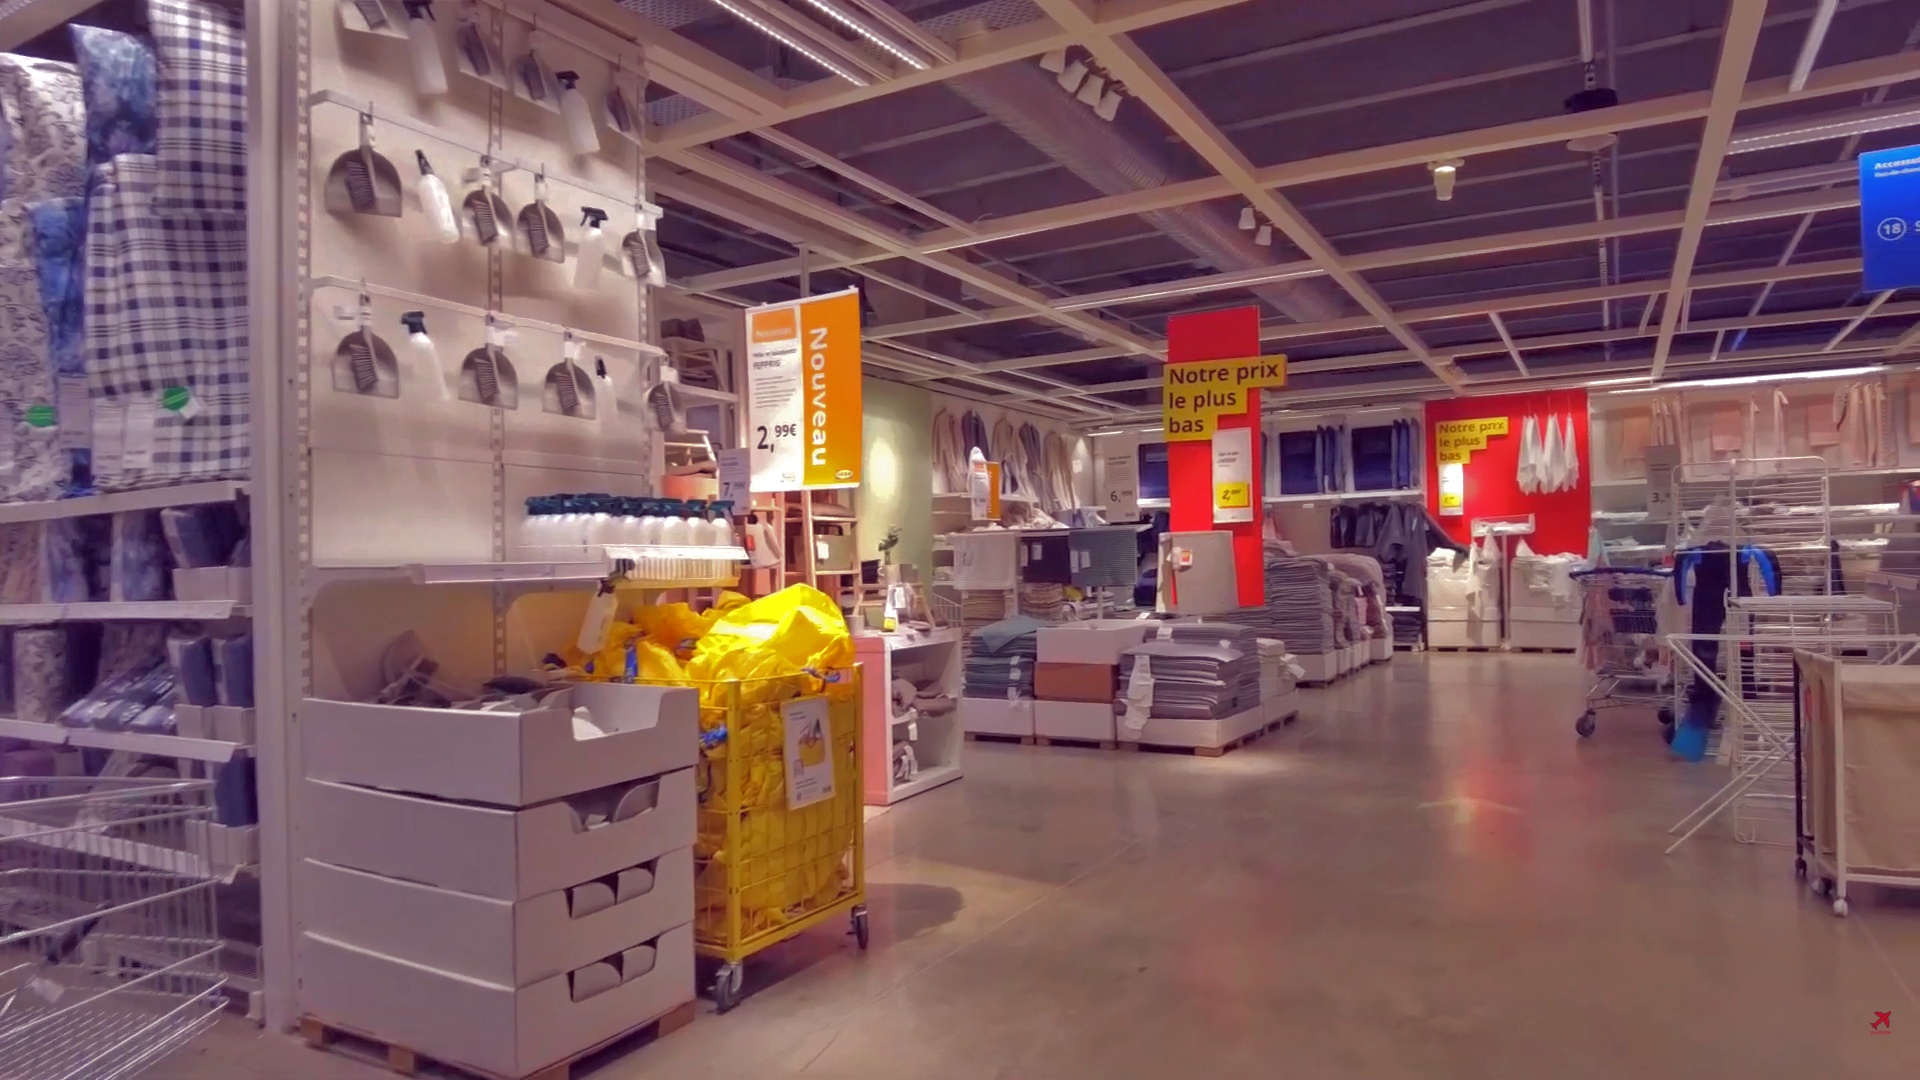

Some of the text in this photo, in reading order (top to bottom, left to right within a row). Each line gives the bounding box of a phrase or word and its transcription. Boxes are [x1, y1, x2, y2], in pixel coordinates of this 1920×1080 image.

[1882, 223, 1902, 235] 18
[1169, 361, 1279, 386] Notre prix
[809, 327, 828, 466] Nouveau
[1169, 389, 1237, 412] le plus
[1169, 416, 1204, 434] bas
[1439, 421, 1476, 434] Notre
[756, 423, 797, 454] 2,99€
[1439, 435, 1480, 449] le plus
[1439, 450, 1462, 462] bas
